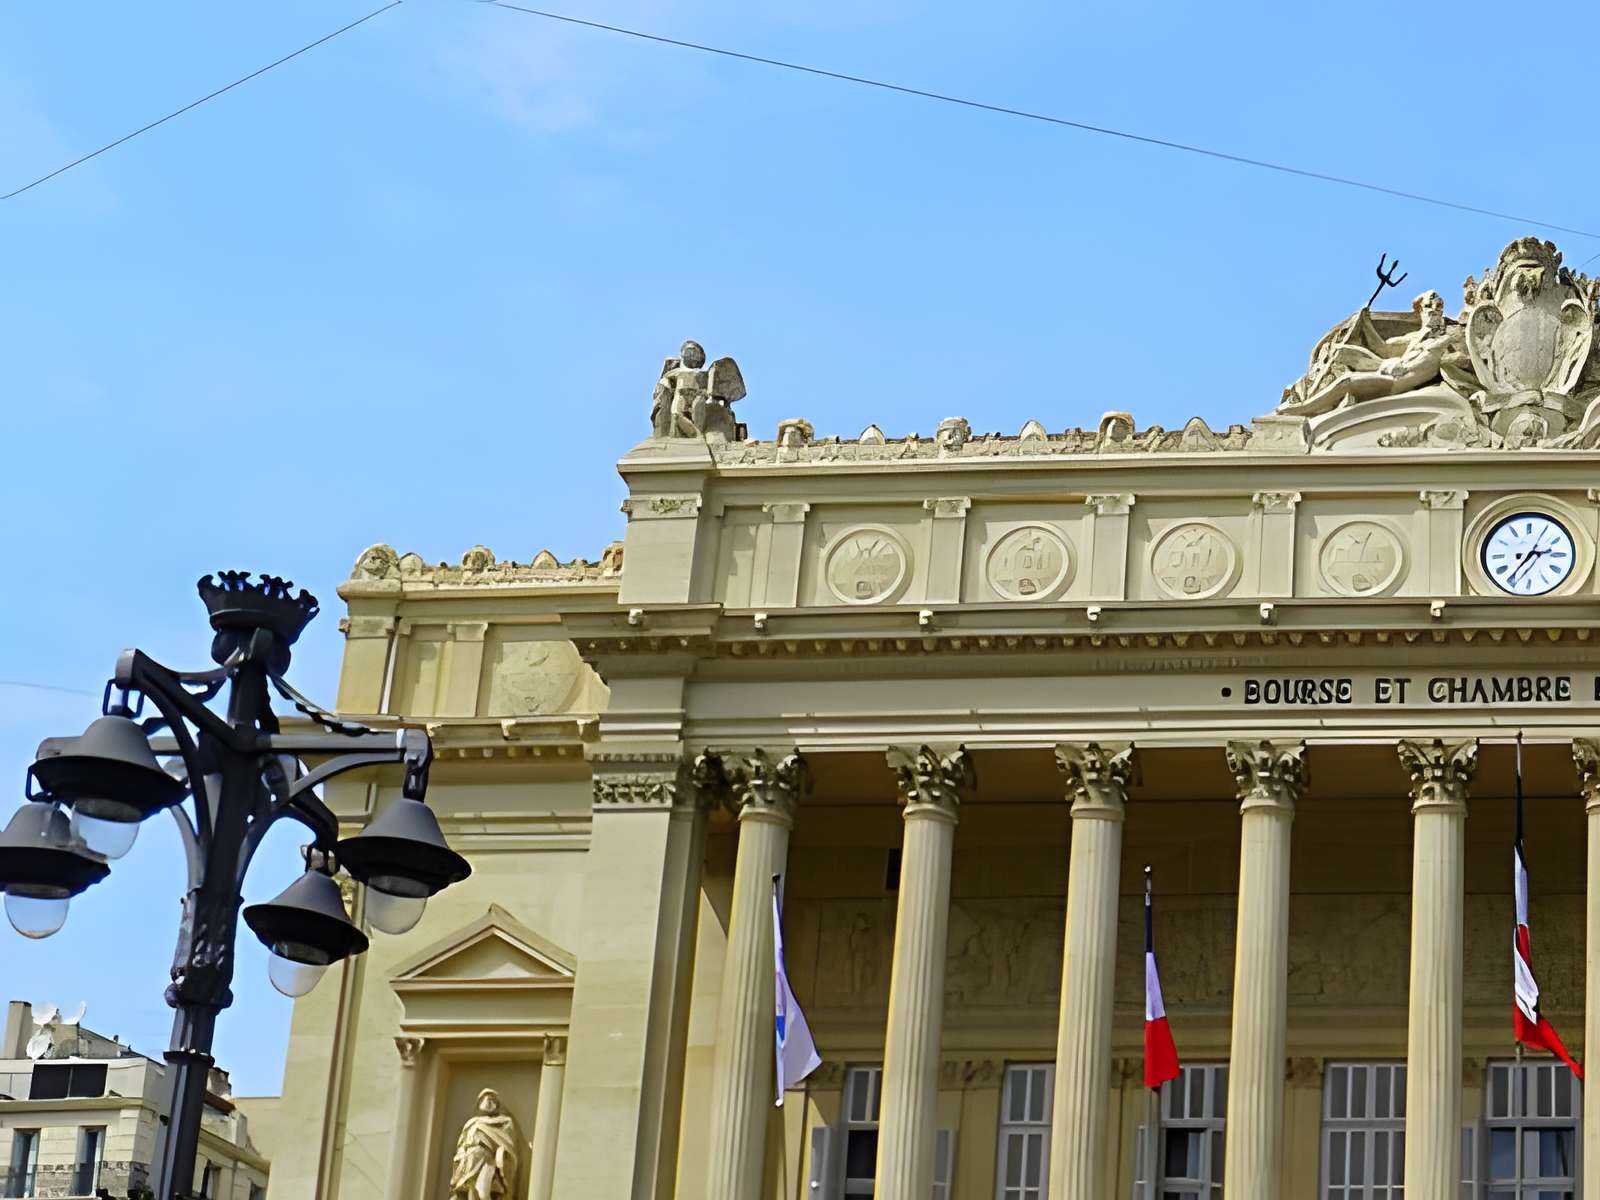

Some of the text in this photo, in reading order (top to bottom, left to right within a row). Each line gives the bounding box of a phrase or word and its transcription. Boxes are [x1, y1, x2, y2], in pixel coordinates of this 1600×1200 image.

[1244, 679, 1352, 704] BOURSE
[1374, 678, 1411, 704] ET
[1427, 676, 1571, 703] CHAMBRE
